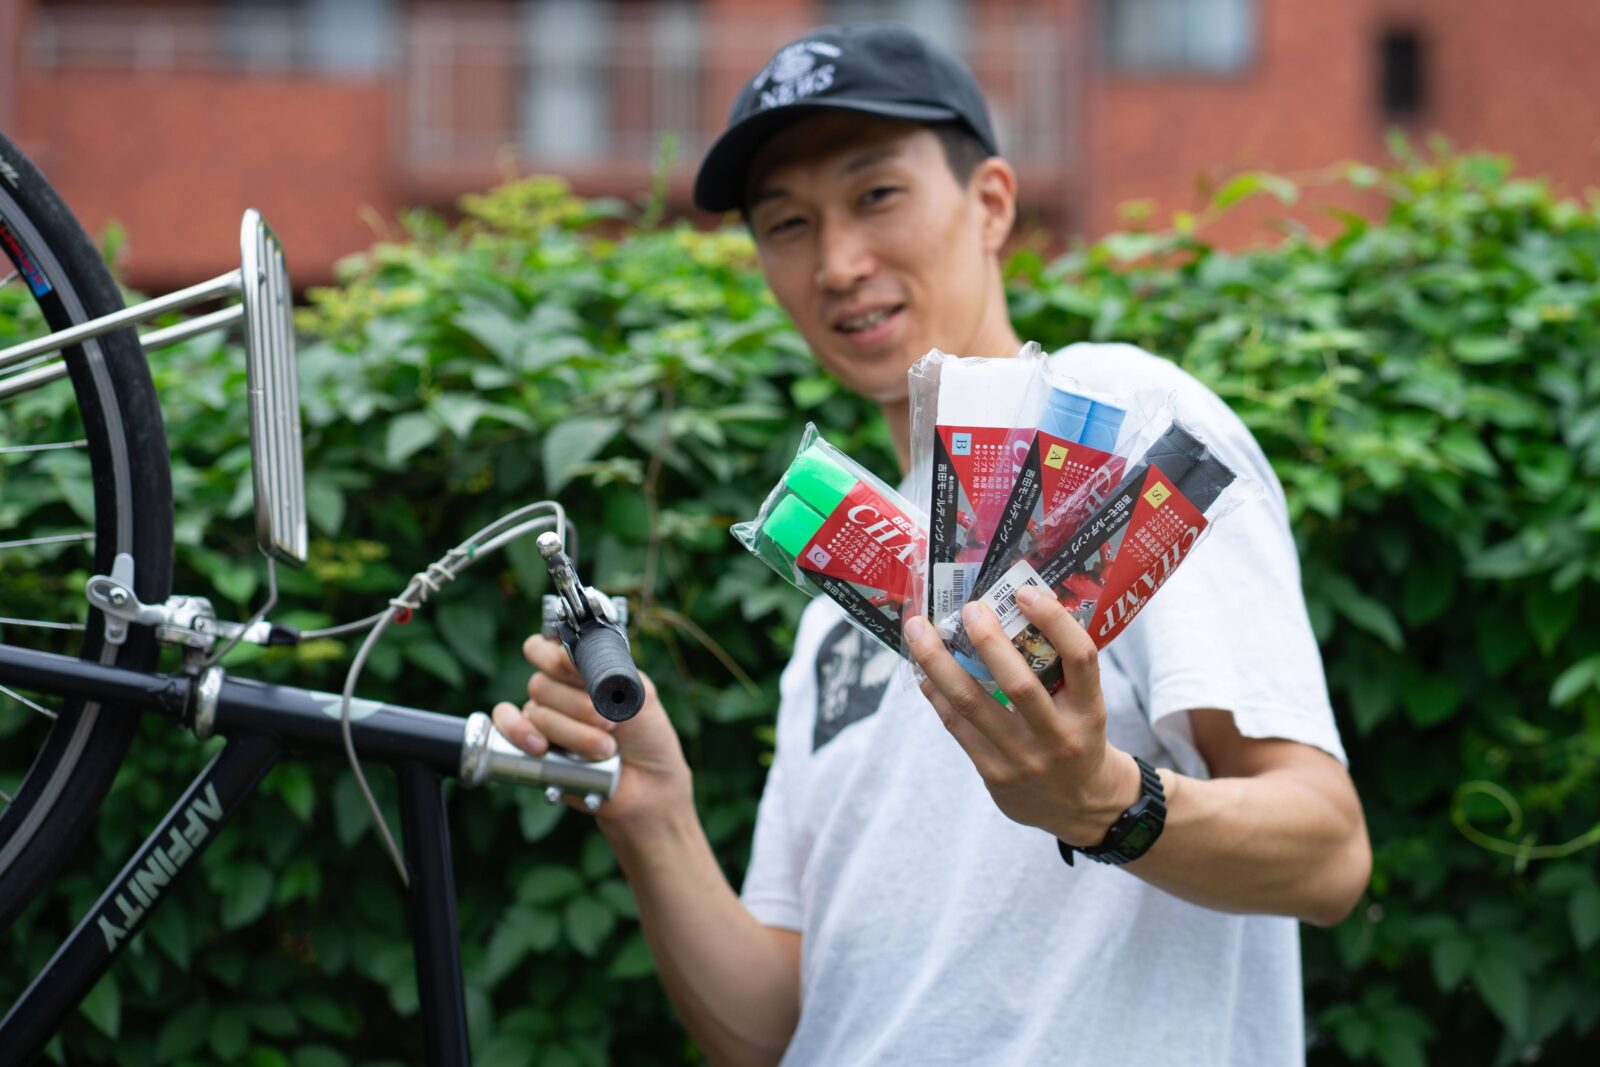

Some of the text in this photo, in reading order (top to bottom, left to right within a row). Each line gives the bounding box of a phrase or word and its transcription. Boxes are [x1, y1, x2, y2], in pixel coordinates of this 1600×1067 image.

[956, 439, 967, 449] B
[1050, 451, 1062, 460] A
[934, 463, 946, 541] 吉田モールディング
[999, 468, 1036, 543] 吉田モールディング
[1152, 490, 1162, 501] S
[1071, 495, 1132, 553] 吉田モールディング
[814, 552, 825, 563] C
[1099, 526, 1199, 637] CHAMP
[823, 581, 885, 633] 吉田モールディング
[993, 583, 1011, 601] ¥1100
[97, 781, 223, 953] AFFINITY
